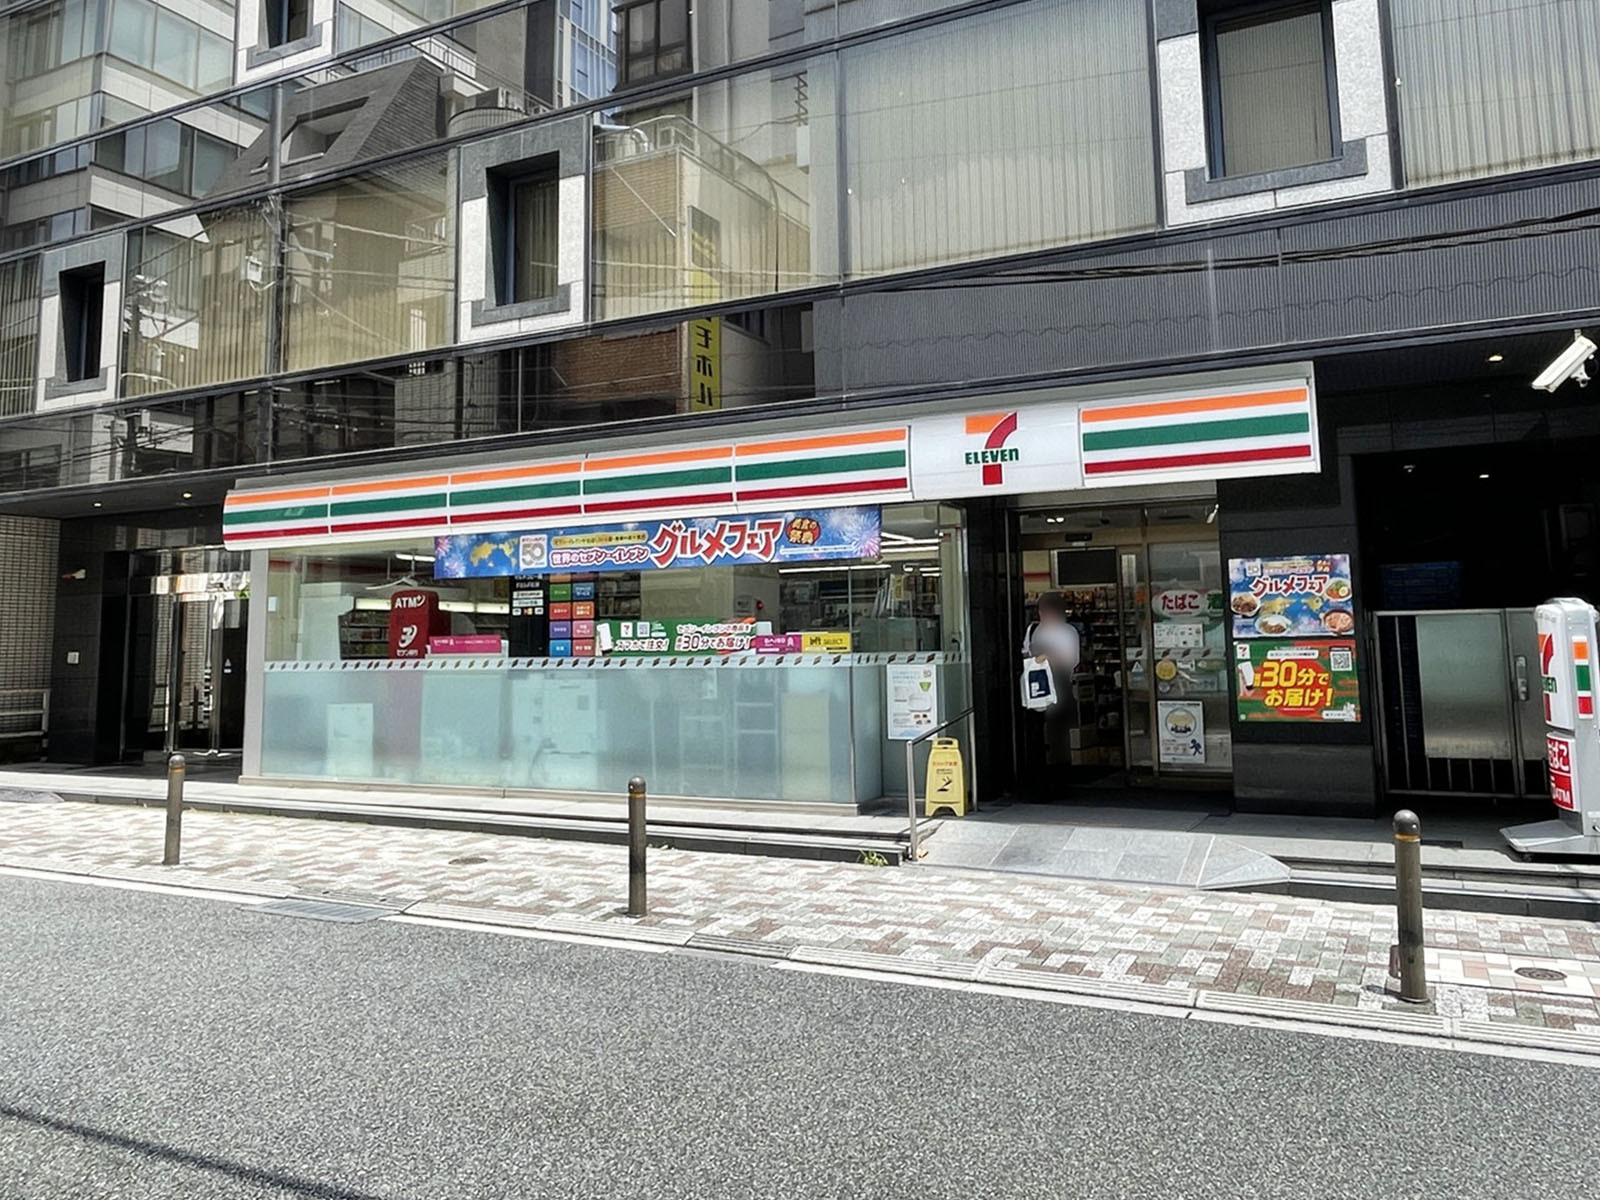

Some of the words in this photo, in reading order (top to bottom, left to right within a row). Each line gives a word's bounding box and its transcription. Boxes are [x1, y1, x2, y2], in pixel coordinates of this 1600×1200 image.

[651, 521, 784, 568] グルメフェア
[1251, 575, 1330, 598] グルメフェア
[394, 594, 419, 609] ATM
[1161, 593, 1201, 611] たばこ
[1264, 688, 1335, 707] お届け!
